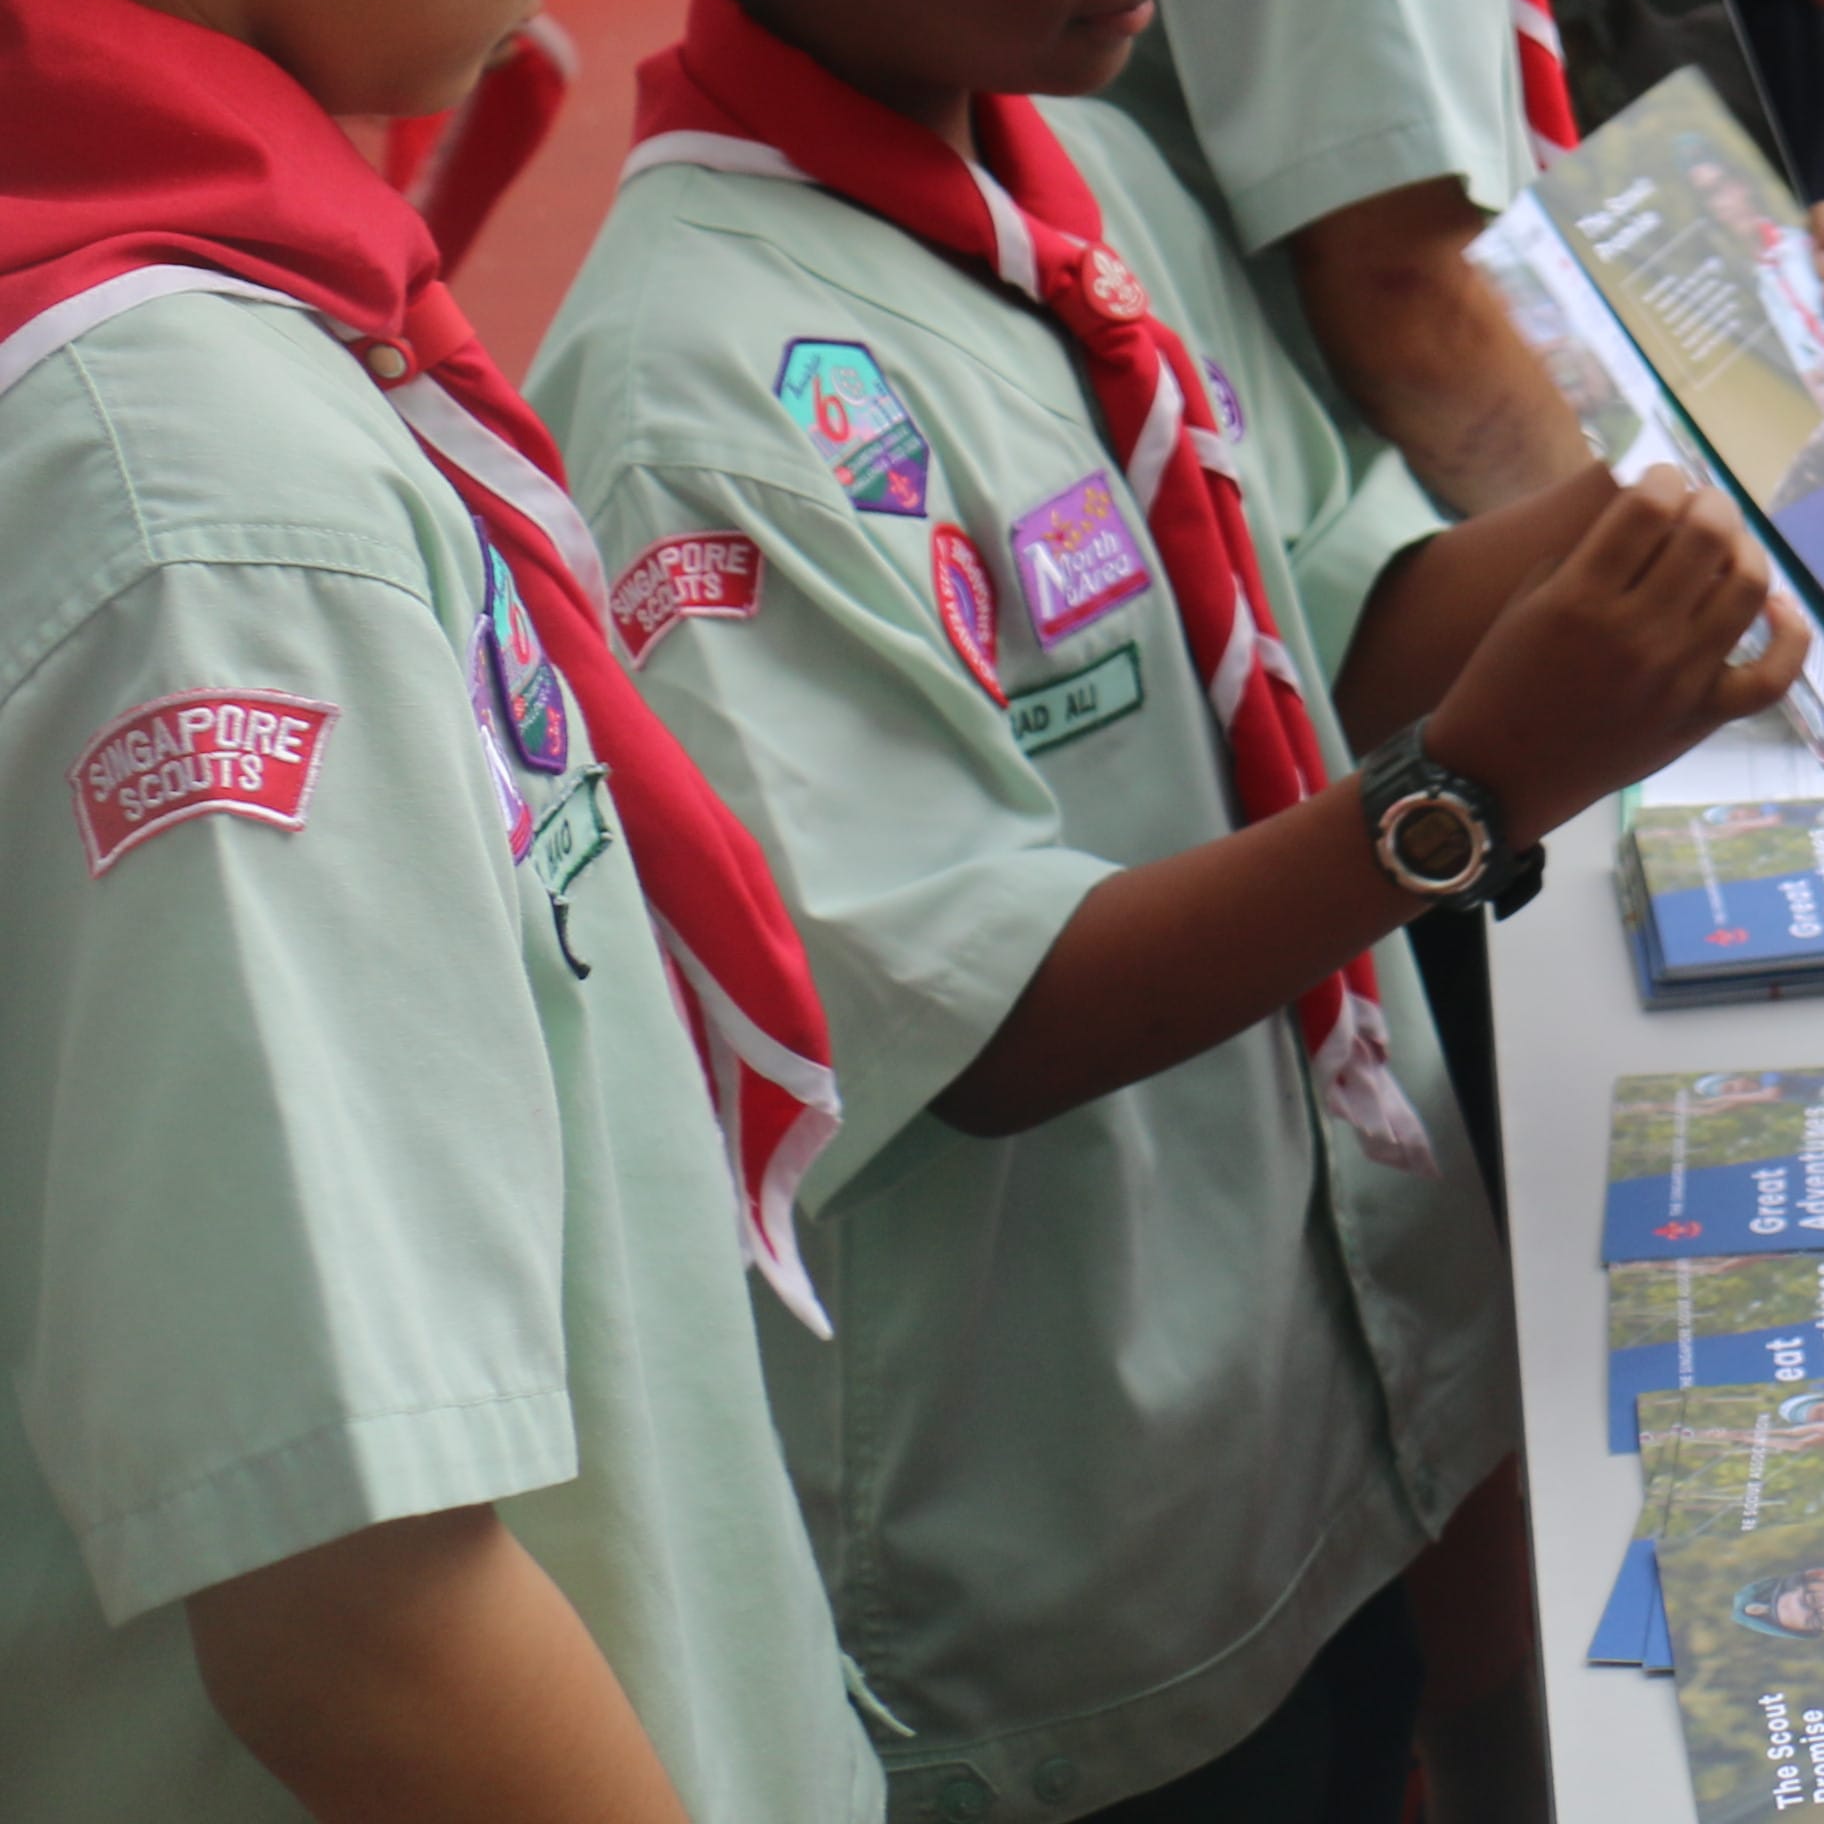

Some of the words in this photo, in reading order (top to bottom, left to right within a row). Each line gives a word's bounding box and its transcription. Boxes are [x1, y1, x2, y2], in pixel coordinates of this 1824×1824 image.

[612, 542, 754, 628] SINGAPORE
[637, 570, 722, 633] SCOUTS
[1023, 530, 1120, 620] North
[1064, 684, 1098, 721] ALI
[87, 704, 314, 805] SINGAPORE
[118, 751, 264, 823] SCOUTS
[1780, 879, 1823, 939] Great
[1749, 1166, 1788, 1235] Great
[1766, 1335, 1806, 1382] eat
[1757, 1691, 1795, 1761] Scout
[1771, 1765, 1805, 1810] The
